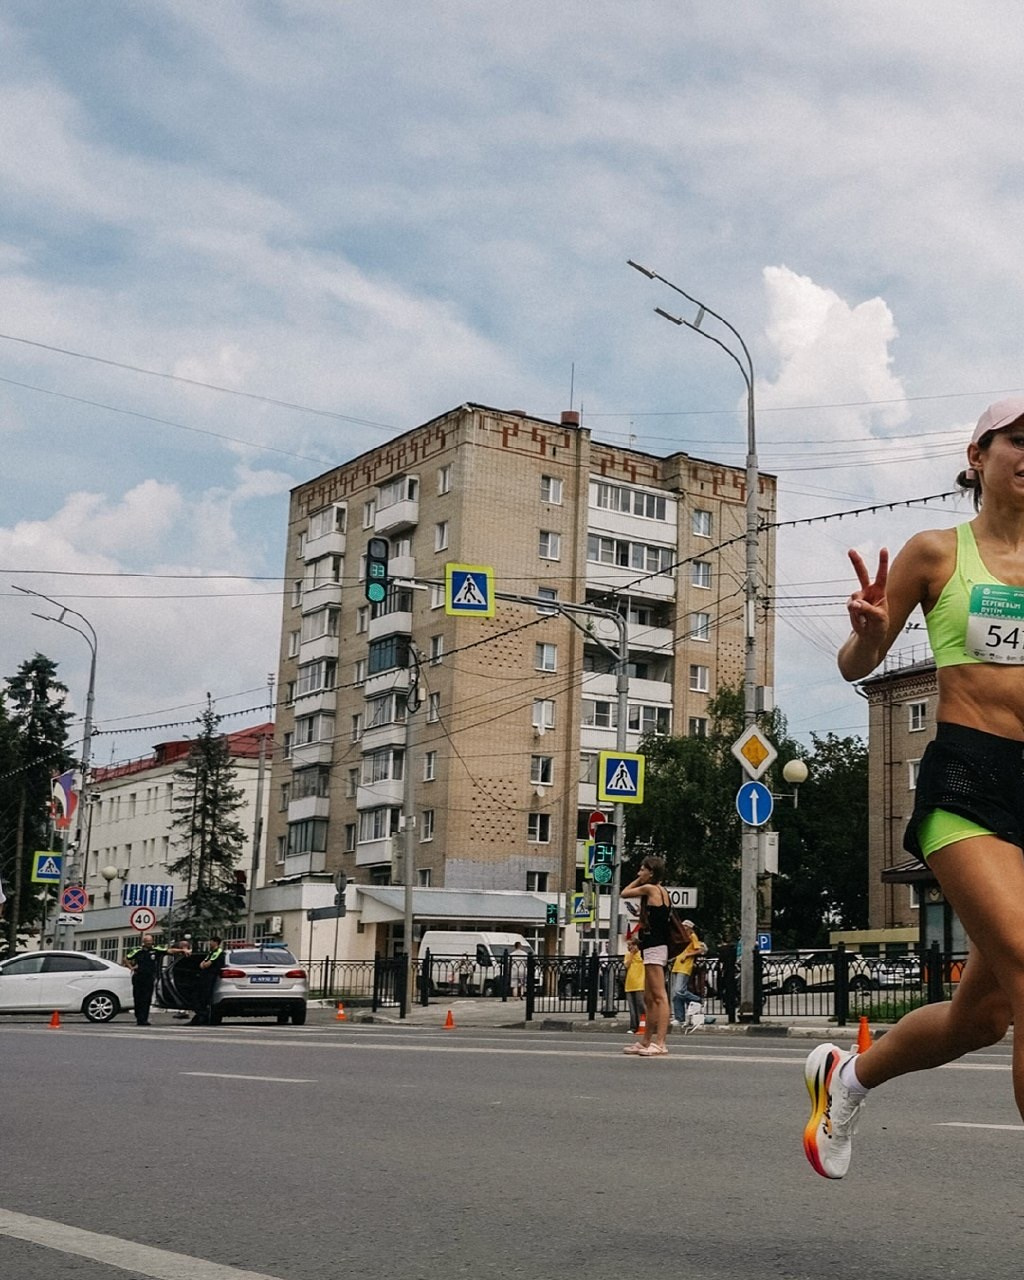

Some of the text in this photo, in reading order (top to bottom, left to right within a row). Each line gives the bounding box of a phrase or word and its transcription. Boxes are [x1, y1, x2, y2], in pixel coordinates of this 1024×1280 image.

[597, 846, 614, 862] 34
[135, 914, 151, 924] 40
[760, 935, 768, 949] P
